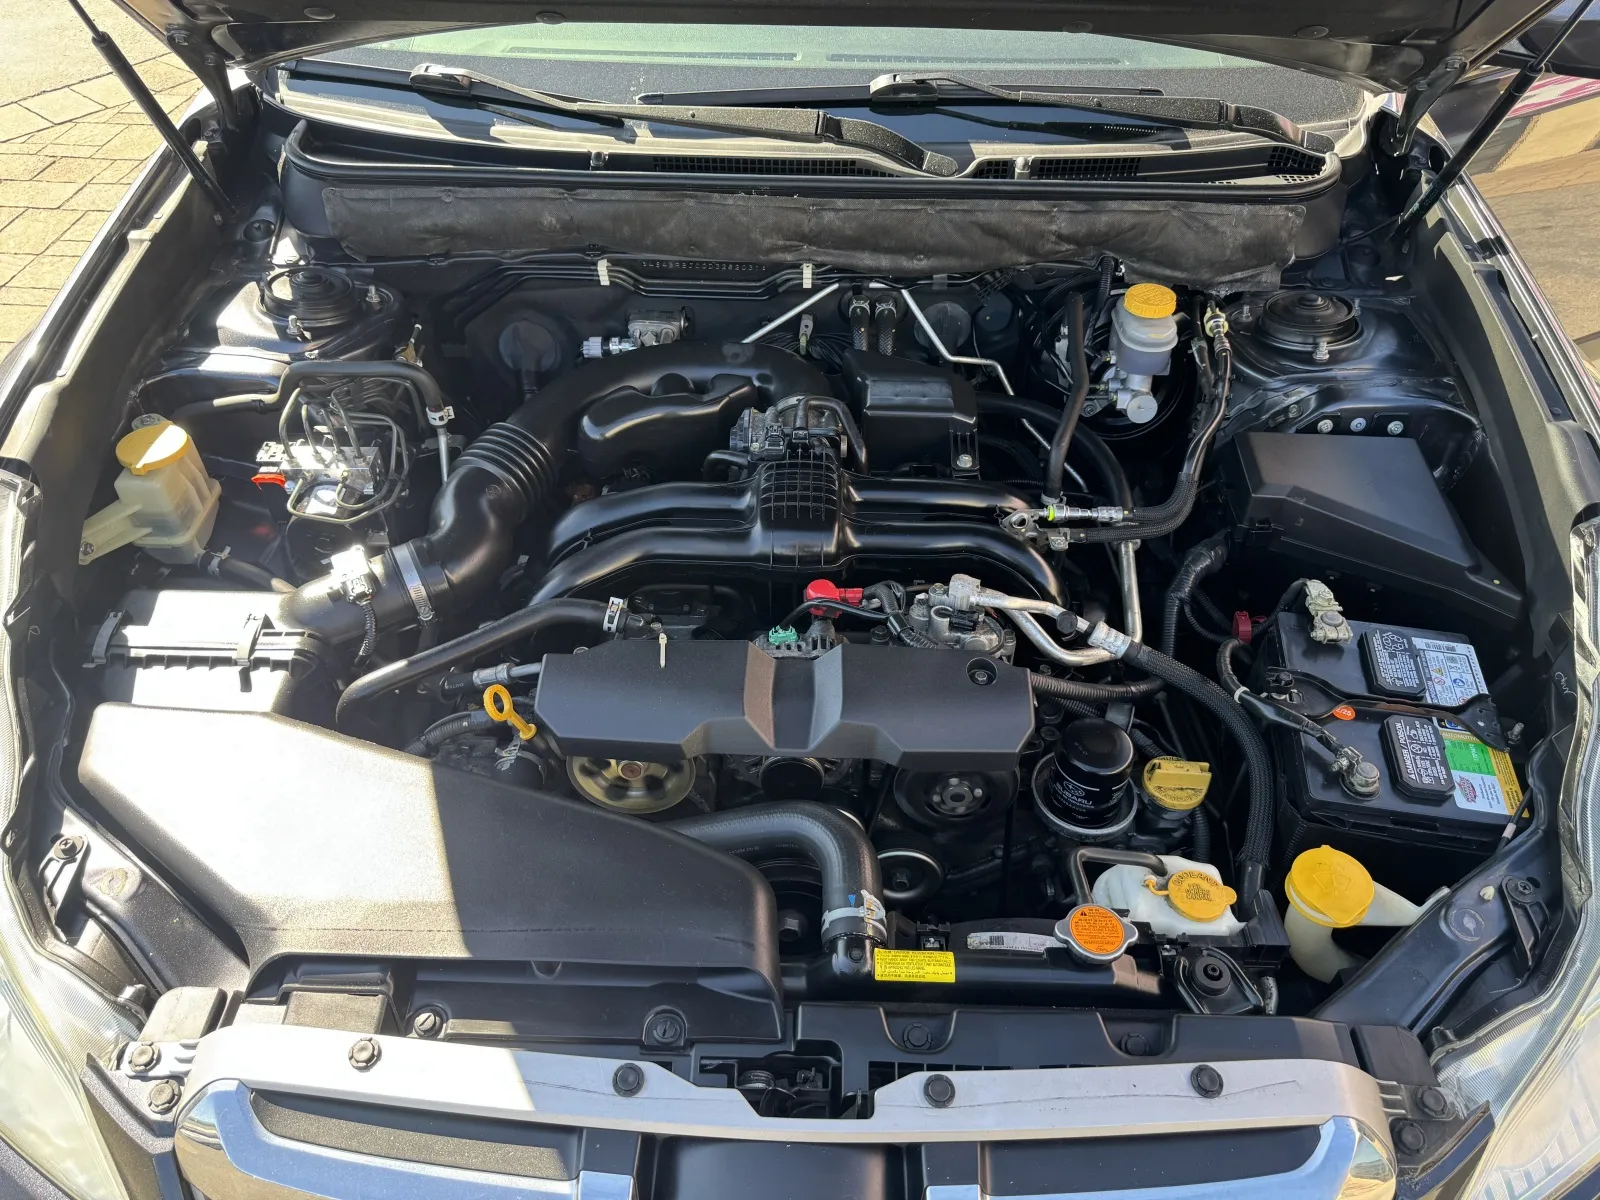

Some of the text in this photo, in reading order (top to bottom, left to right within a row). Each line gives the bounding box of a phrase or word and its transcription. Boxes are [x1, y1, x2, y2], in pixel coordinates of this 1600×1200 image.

[1393, 722, 1408, 745] POISON
[1056, 782, 1093, 805] SUBARU
[1172, 871, 1219, 886] COOLANT
